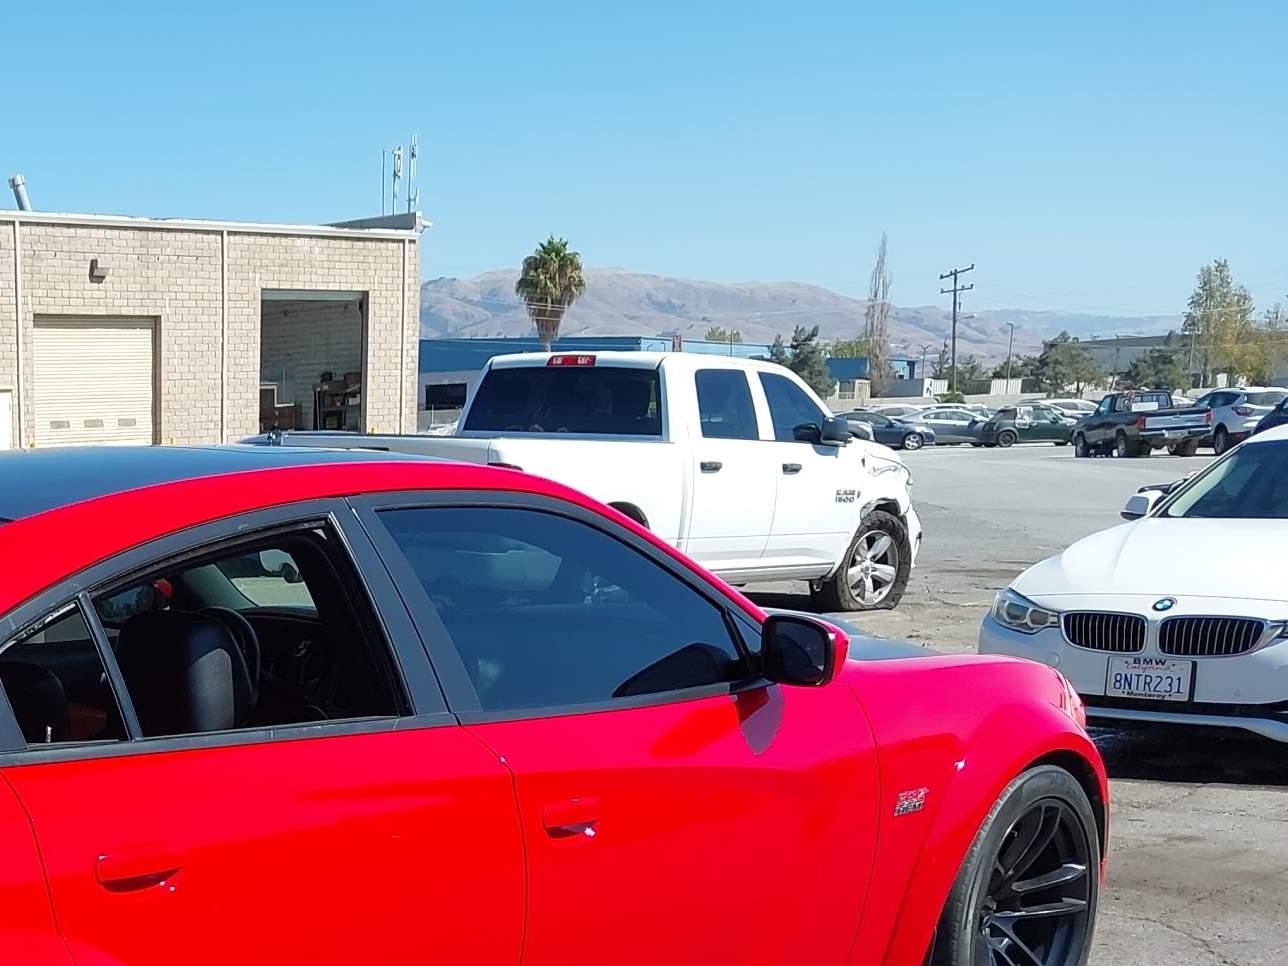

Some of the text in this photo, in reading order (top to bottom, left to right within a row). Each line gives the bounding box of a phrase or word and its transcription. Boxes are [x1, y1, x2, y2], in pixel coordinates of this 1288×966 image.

[1133, 657, 1167, 666] BMW
[1113, 672, 1184, 694] 8NTR231
[1126, 690, 1167, 700] Monterey
